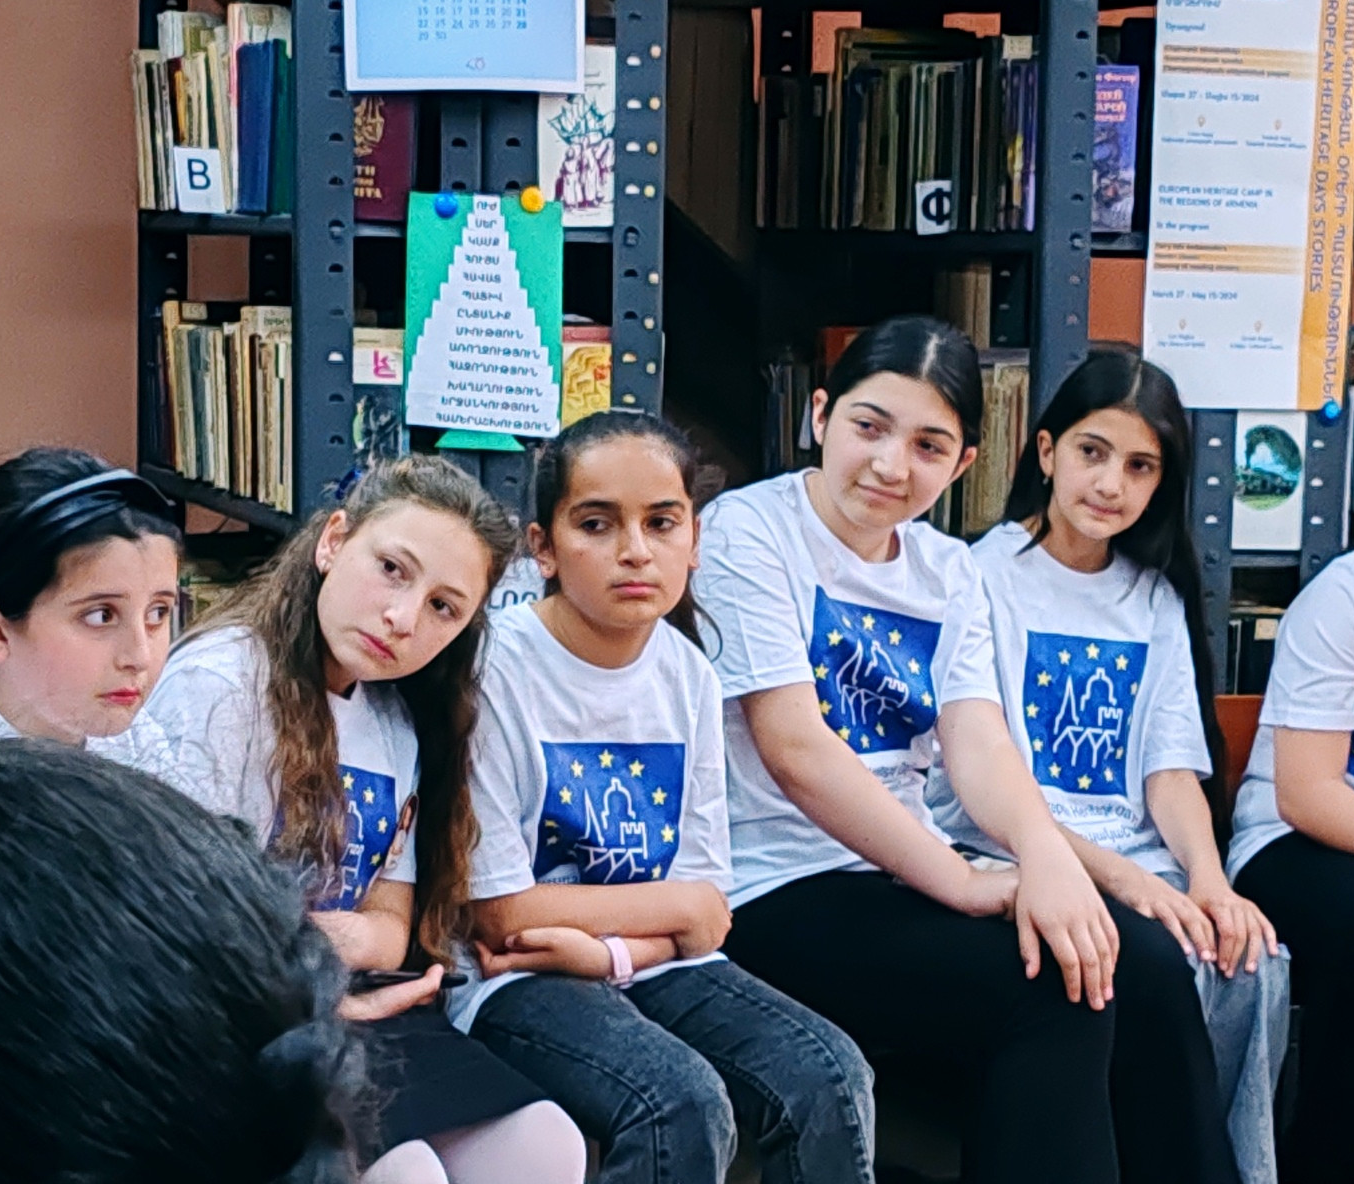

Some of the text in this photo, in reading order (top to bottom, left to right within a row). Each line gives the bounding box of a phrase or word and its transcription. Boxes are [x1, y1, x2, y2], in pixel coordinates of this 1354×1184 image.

[1317, 78, 1335, 164] HERITAGE
[1158, 185, 1201, 194] EUROPEAN
[1203, 187, 1239, 196] HERITAGE
[1242, 188, 1262, 196] CAMP
[1313, 170, 1329, 215] DAYS
[476, 201, 497, 210] ՈՒԺ
[922, 187, 952, 226] Ф
[1159, 197, 1258, 209] THE REGIONS OF ARMENIA
[475, 219, 497, 229] ՍԵՐ
[468, 236, 500, 246] ԿԱՄՔ
[464, 254, 500, 265] ՀՈՒՅՍ
[1310, 219, 1326, 292] STORIES
[463, 272, 501, 283] ՀԱՎԱՏ
[462, 290, 503, 302] ՊԱՏԻՎ
[457, 308, 511, 320] ԸՆՏԱՆԻՔ
[455, 326, 524, 339] ՄԻՈՒԹՅՈՒՆ
